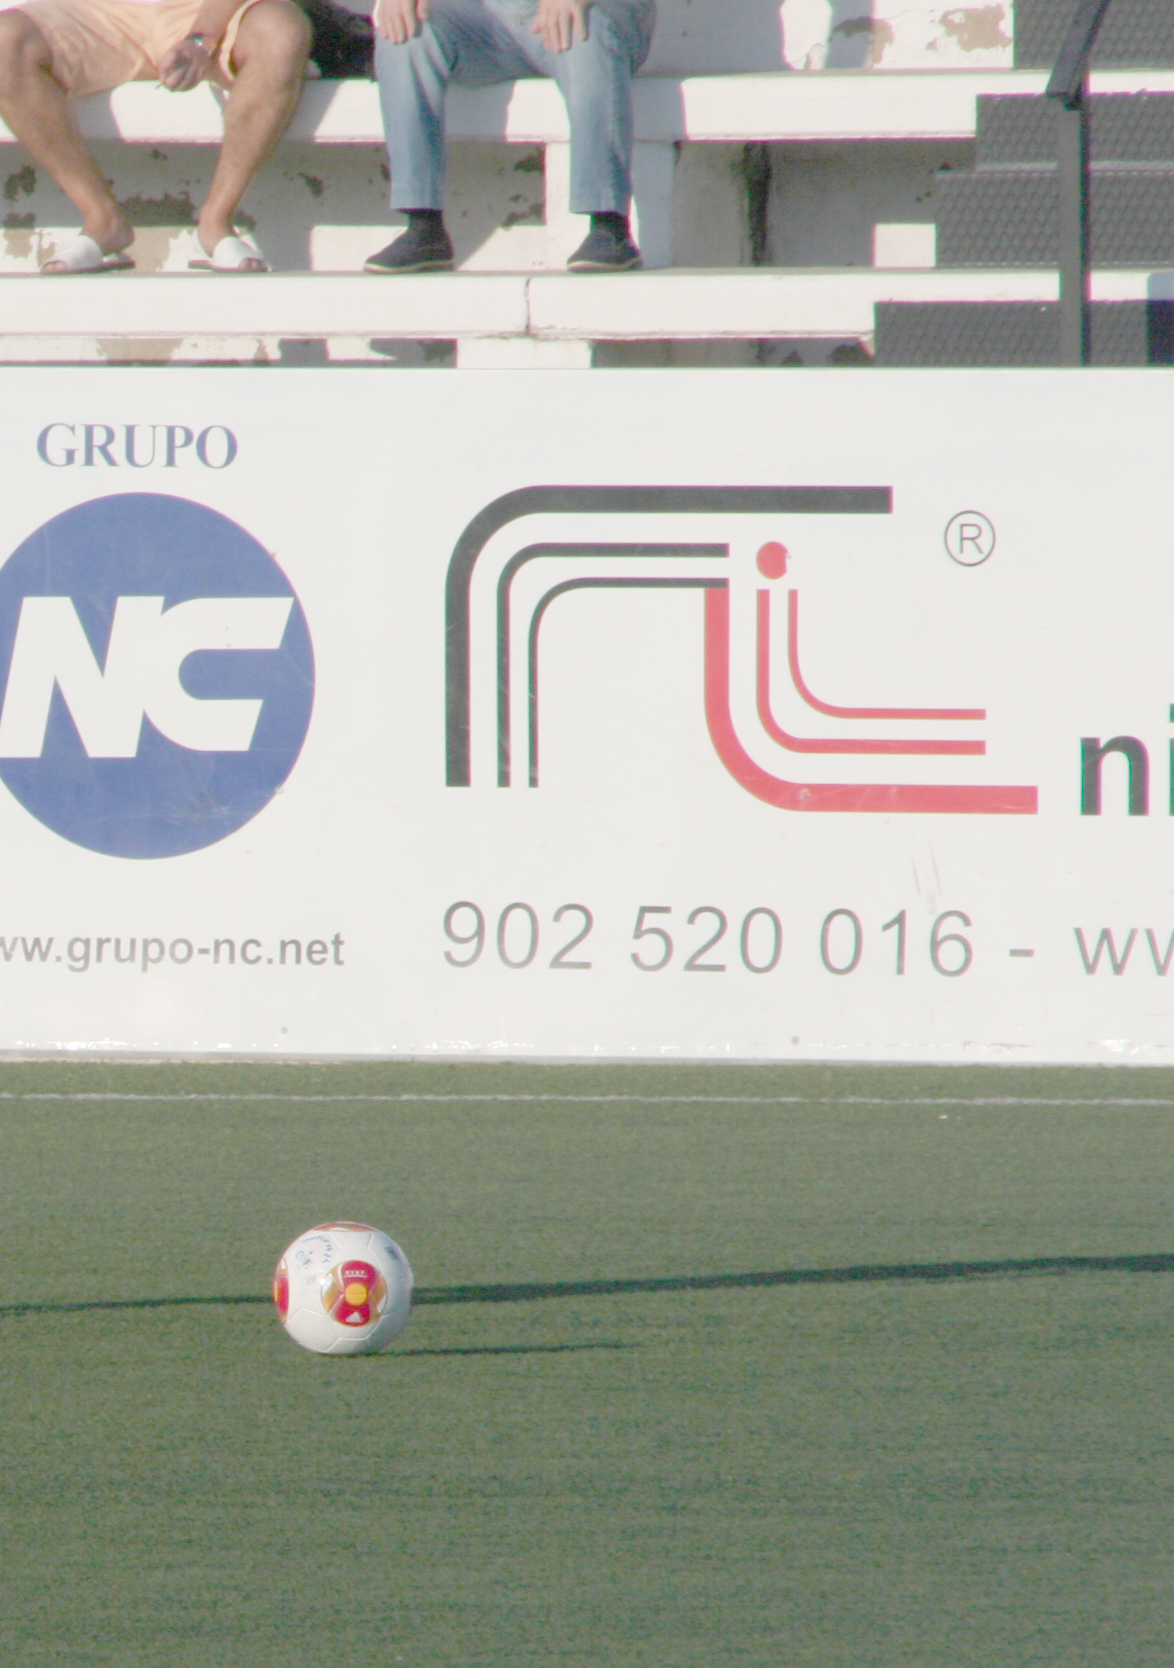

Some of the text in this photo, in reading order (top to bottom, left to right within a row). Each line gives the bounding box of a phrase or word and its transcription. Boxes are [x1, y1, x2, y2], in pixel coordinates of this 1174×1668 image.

[36, 422, 238, 469] GRUPO
[442, 900, 595, 970] 902
[630, 905, 784, 975] 520
[819, 907, 974, 978] 016
